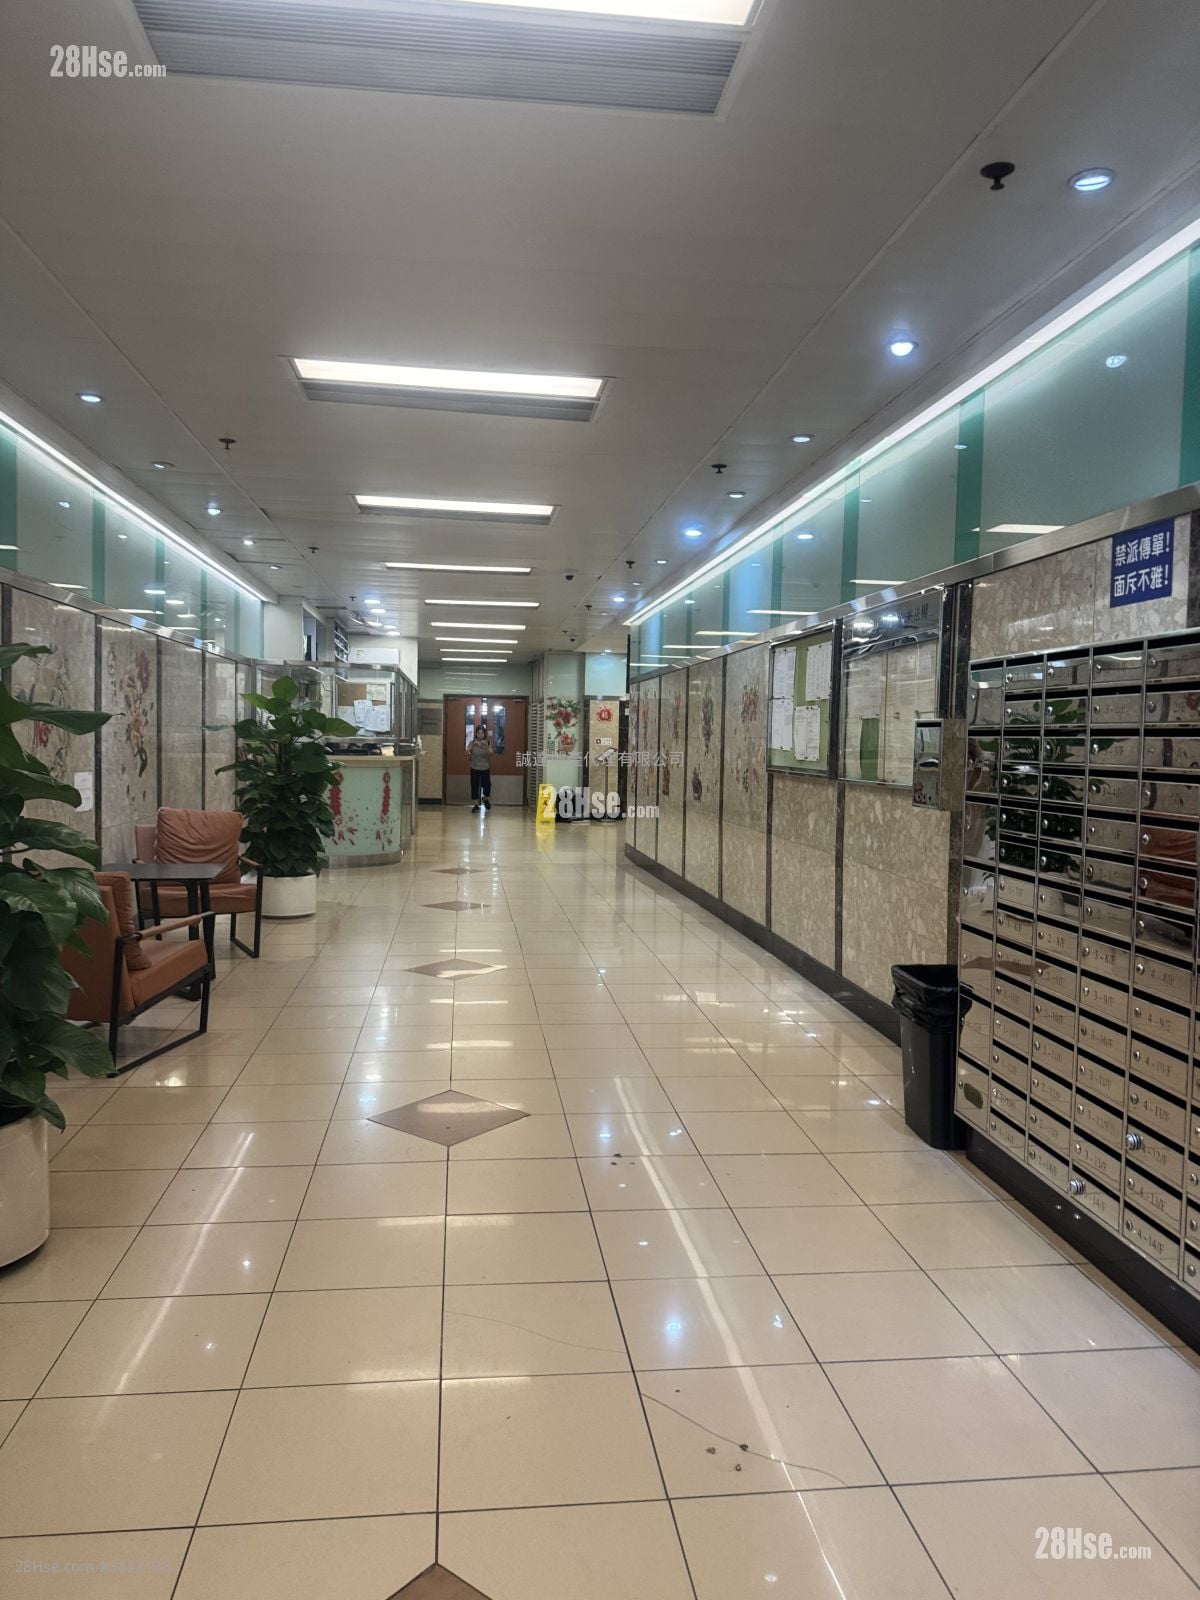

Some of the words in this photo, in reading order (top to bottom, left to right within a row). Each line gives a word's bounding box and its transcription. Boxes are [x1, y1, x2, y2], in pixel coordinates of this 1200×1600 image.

[1115, 531, 1170, 567] 禁派傳單!
[1114, 564, 1168, 597] 面斥不雅!
